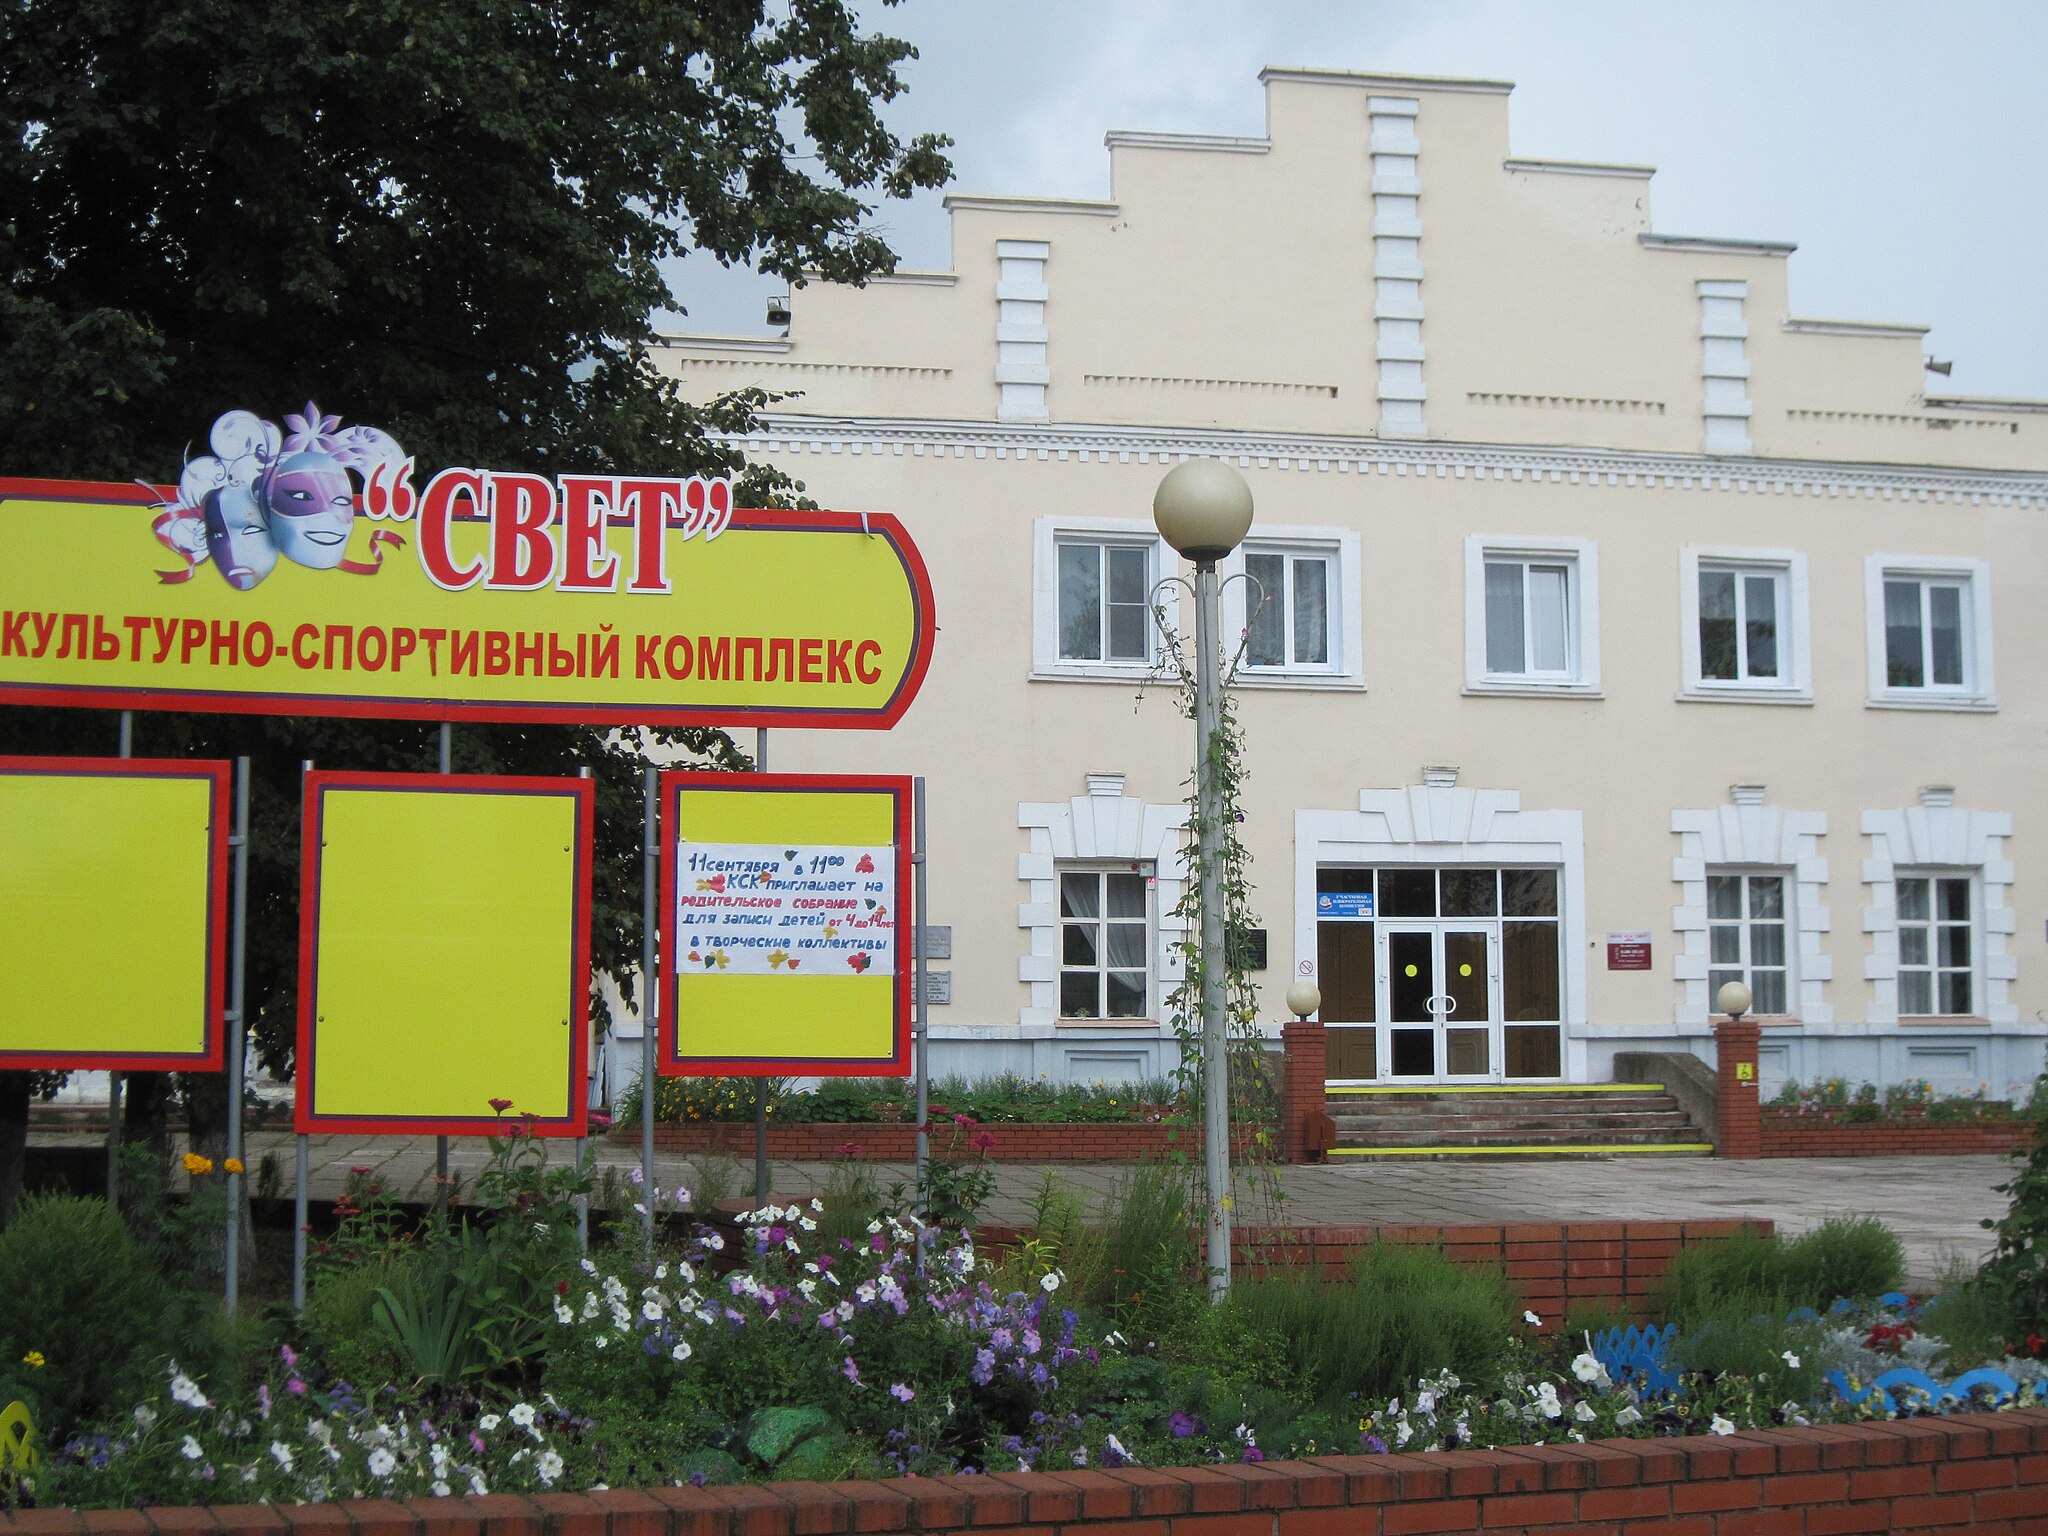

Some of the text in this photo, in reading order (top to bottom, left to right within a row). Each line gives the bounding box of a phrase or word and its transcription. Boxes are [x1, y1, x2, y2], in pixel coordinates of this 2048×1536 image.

[1, 611, 882, 685] КУЛЬТУРНО-СПОРТИВНЫЙ КОМПЛЕКС
[727, 873, 883, 892] КСК приглашает на
[682, 913, 716, 925] для
[722, 914, 773, 925] записи
[778, 911, 825, 927] детей
[829, 918, 843, 927] от
[690, 936, 887, 950] в творческие коллективы
